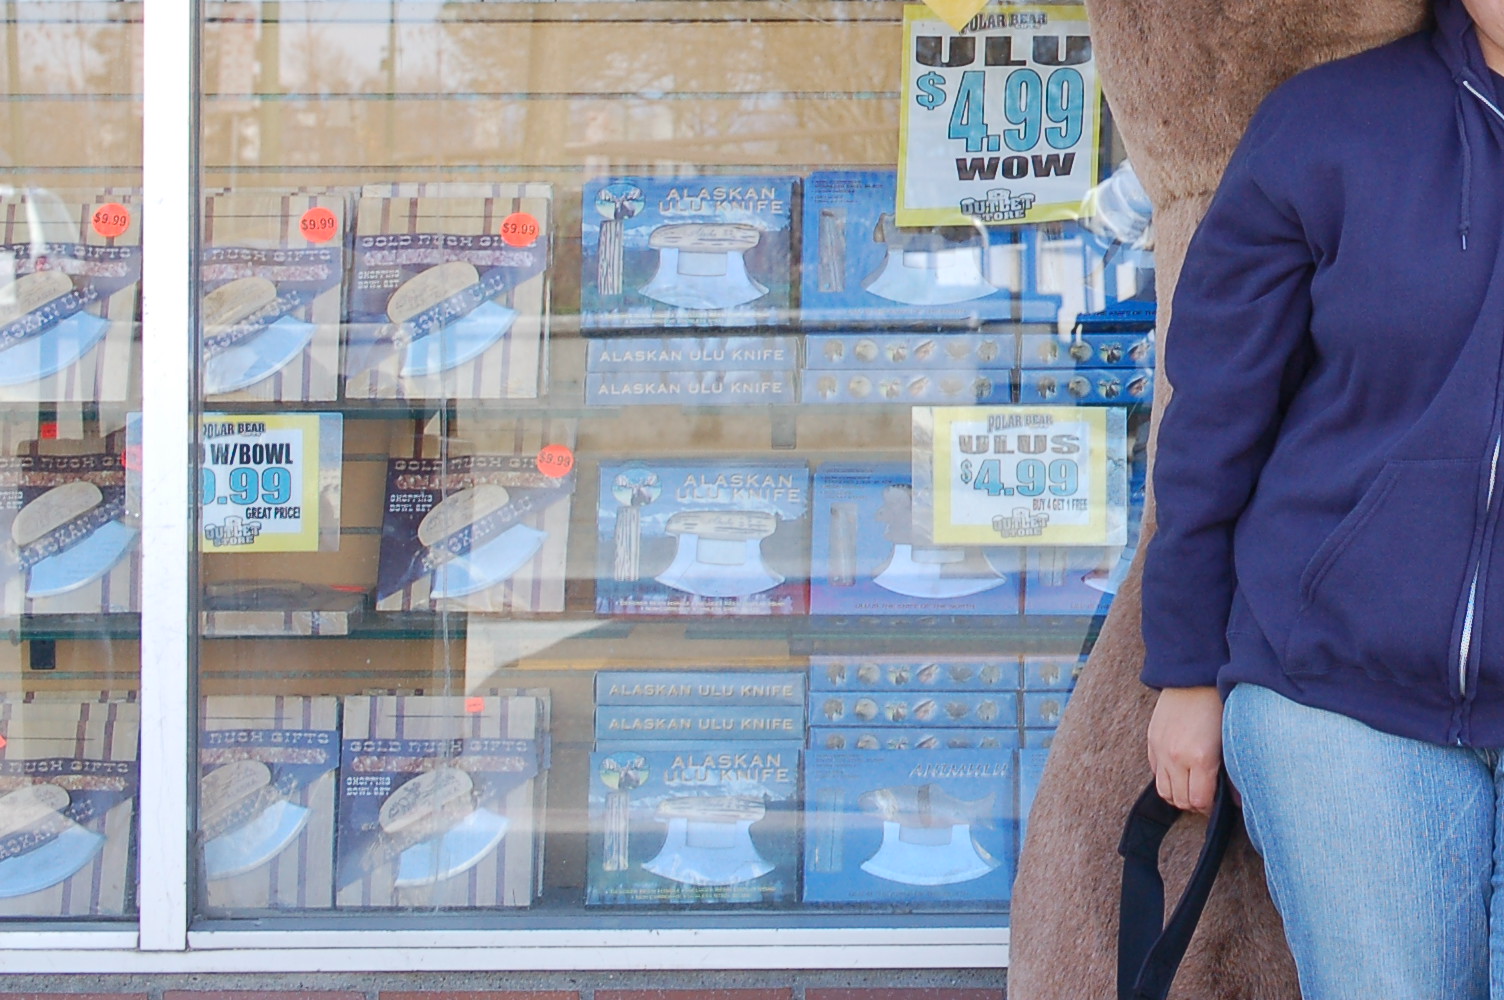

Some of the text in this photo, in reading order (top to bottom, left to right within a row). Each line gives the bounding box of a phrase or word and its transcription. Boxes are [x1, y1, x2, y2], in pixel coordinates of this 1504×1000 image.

[1008, 12, 1047, 28] BEAR
[916, 35, 1092, 67] ULU
[916, 68, 1084, 152] $4.99
[956, 152, 1076, 180] WOW
[666, 186, 776, 200] ALASKAN
[658, 200, 784, 214] ULU KNIFE
[960, 192, 1035, 216] OUTLET
[93, 211, 127, 227] $9.99
[975, 210, 1026, 223] STORE
[301, 217, 335, 231] $9.99
[502, 222, 537, 236] $9.99
[601, 349, 785, 362] ALASKAN ULU KNIFE
[598, 381, 783, 395] ALASKAN ULU KNIFE
[238, 422, 266, 434] BEAR
[959, 435, 1081, 455] ULUS
[210, 443, 293, 465] W/BOWL
[683, 473, 793, 487] ALASKAN
[960, 458, 1079, 497] $4.99
[675, 488, 801, 502] ULU KNIFE
[1032, 499, 1046, 511] BUY
[1053, 499, 1066, 511] GET
[1071, 499, 1088, 511] FREE
[245, 506, 272, 520] GREAT
[992, 513, 1049, 533] OUTLET
[204, 521, 262, 541] OUTLET
[213, 535, 254, 547] STORE
[609, 684, 793, 697] ALASKAN ULU KNIFE
[609, 718, 793, 731] ALASKAN ULU KNIFE
[671, 753, 781, 769] ALASKAN
[663, 769, 789, 784] ULU KNIFE
